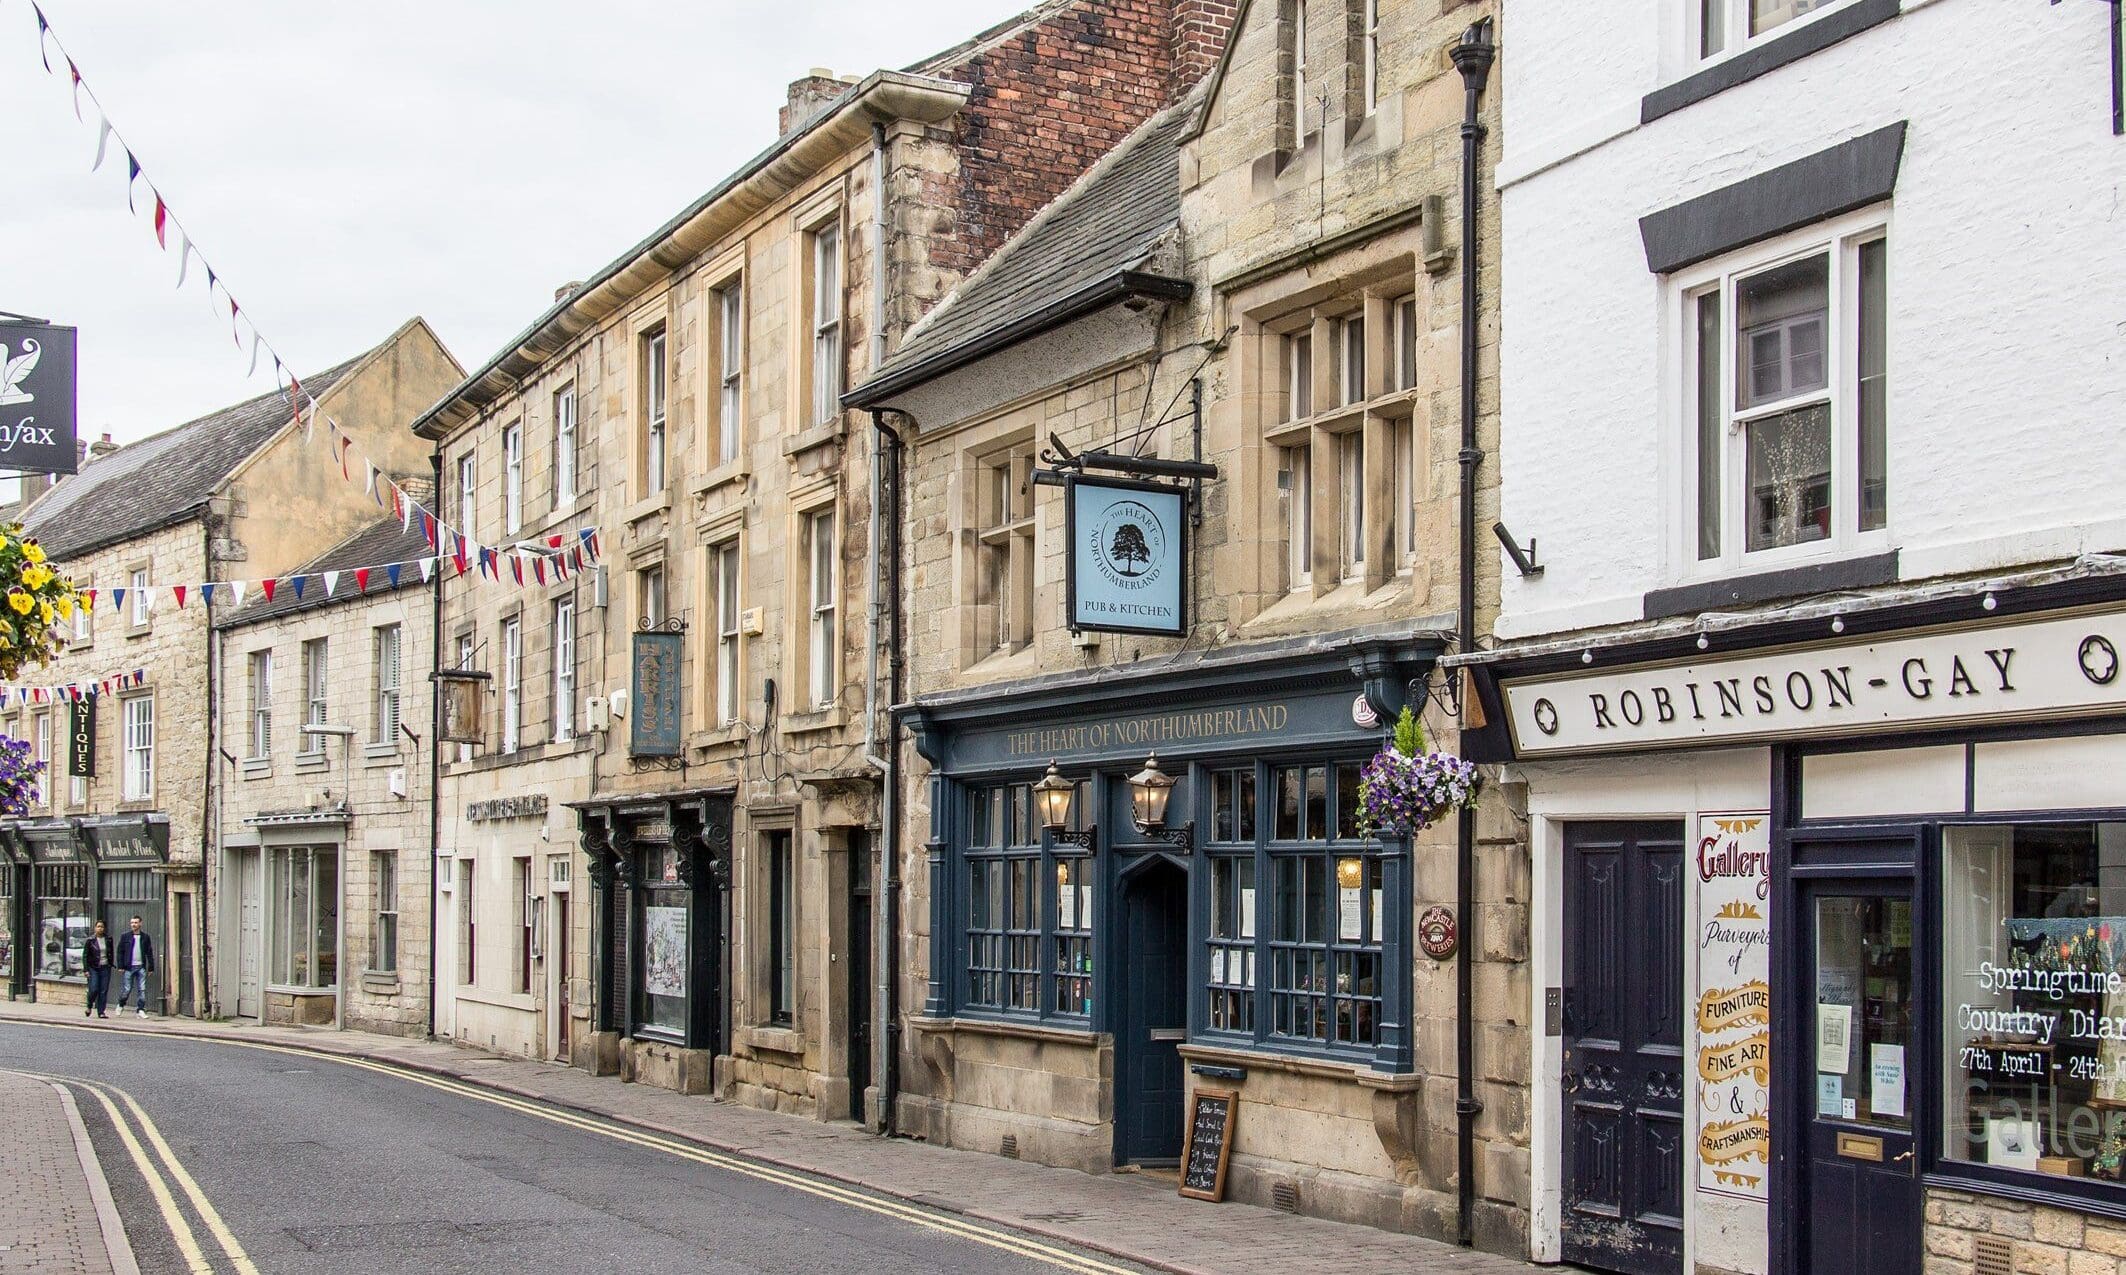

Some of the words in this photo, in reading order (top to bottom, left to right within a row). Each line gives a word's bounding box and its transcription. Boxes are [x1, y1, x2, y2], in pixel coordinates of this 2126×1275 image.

[1111, 510, 1124, 519] THE
[1126, 507, 1158, 534] HEART
[1090, 529, 1161, 590] NORTHUMBERLAND
[1085, 600, 1106, 612] PUB
[1109, 603, 1117, 612] &
[1120, 604, 1172, 617] KITCHEN
[1008, 733, 1036, 755] THE
[1040, 727, 1088, 752] HEART
[1090, 723, 1111, 747] OF
[1115, 705, 1288, 745] NORTHUMBERLAND
[1696, 834, 1770, 900] Gallery
[1421, 914, 1455, 930] NEWCASTLE
[1728, 948, 1742, 975] of
[1980, 961, 2121, 1000] Springtime
[1706, 991, 1768, 1018] FURNITURE
[1958, 1003, 2055, 1044] Country
[1707, 1053, 1736, 1073] FINE
[1741, 1043, 1767, 1065] ART
[1959, 1047, 1992, 1071] 27th
[2000, 1051, 2044, 1076] April
[2069, 1055, 2106, 1080] 24th
[1730, 1086, 1744, 1114] &
